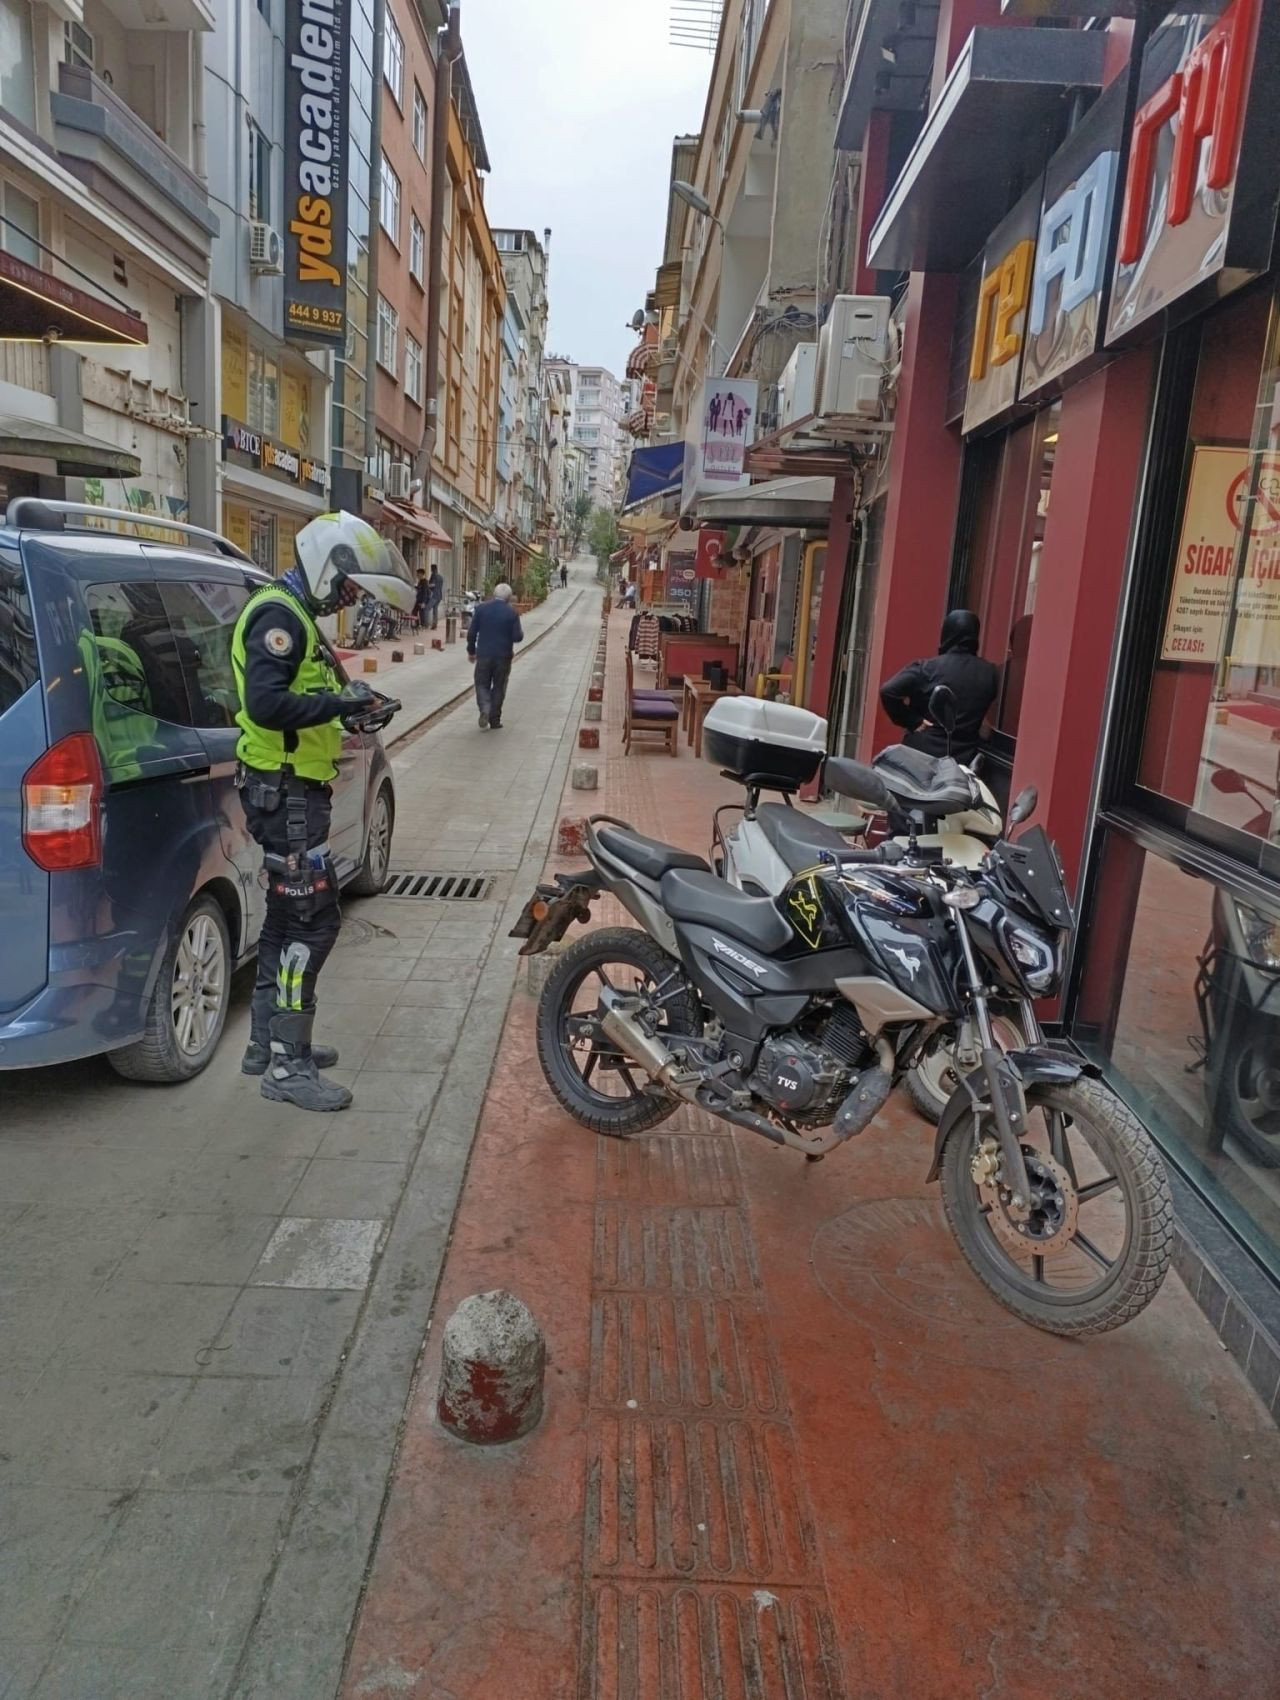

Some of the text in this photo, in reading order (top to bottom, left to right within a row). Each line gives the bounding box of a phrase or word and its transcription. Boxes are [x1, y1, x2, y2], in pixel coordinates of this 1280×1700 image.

[289, 303, 343, 325] 444 9 937
[240, 429, 261, 456] BTCE
[264, 441, 299, 479] ydsacademy
[712, 936, 769, 978] RAIDER
[777, 1075, 798, 1091] TVS
